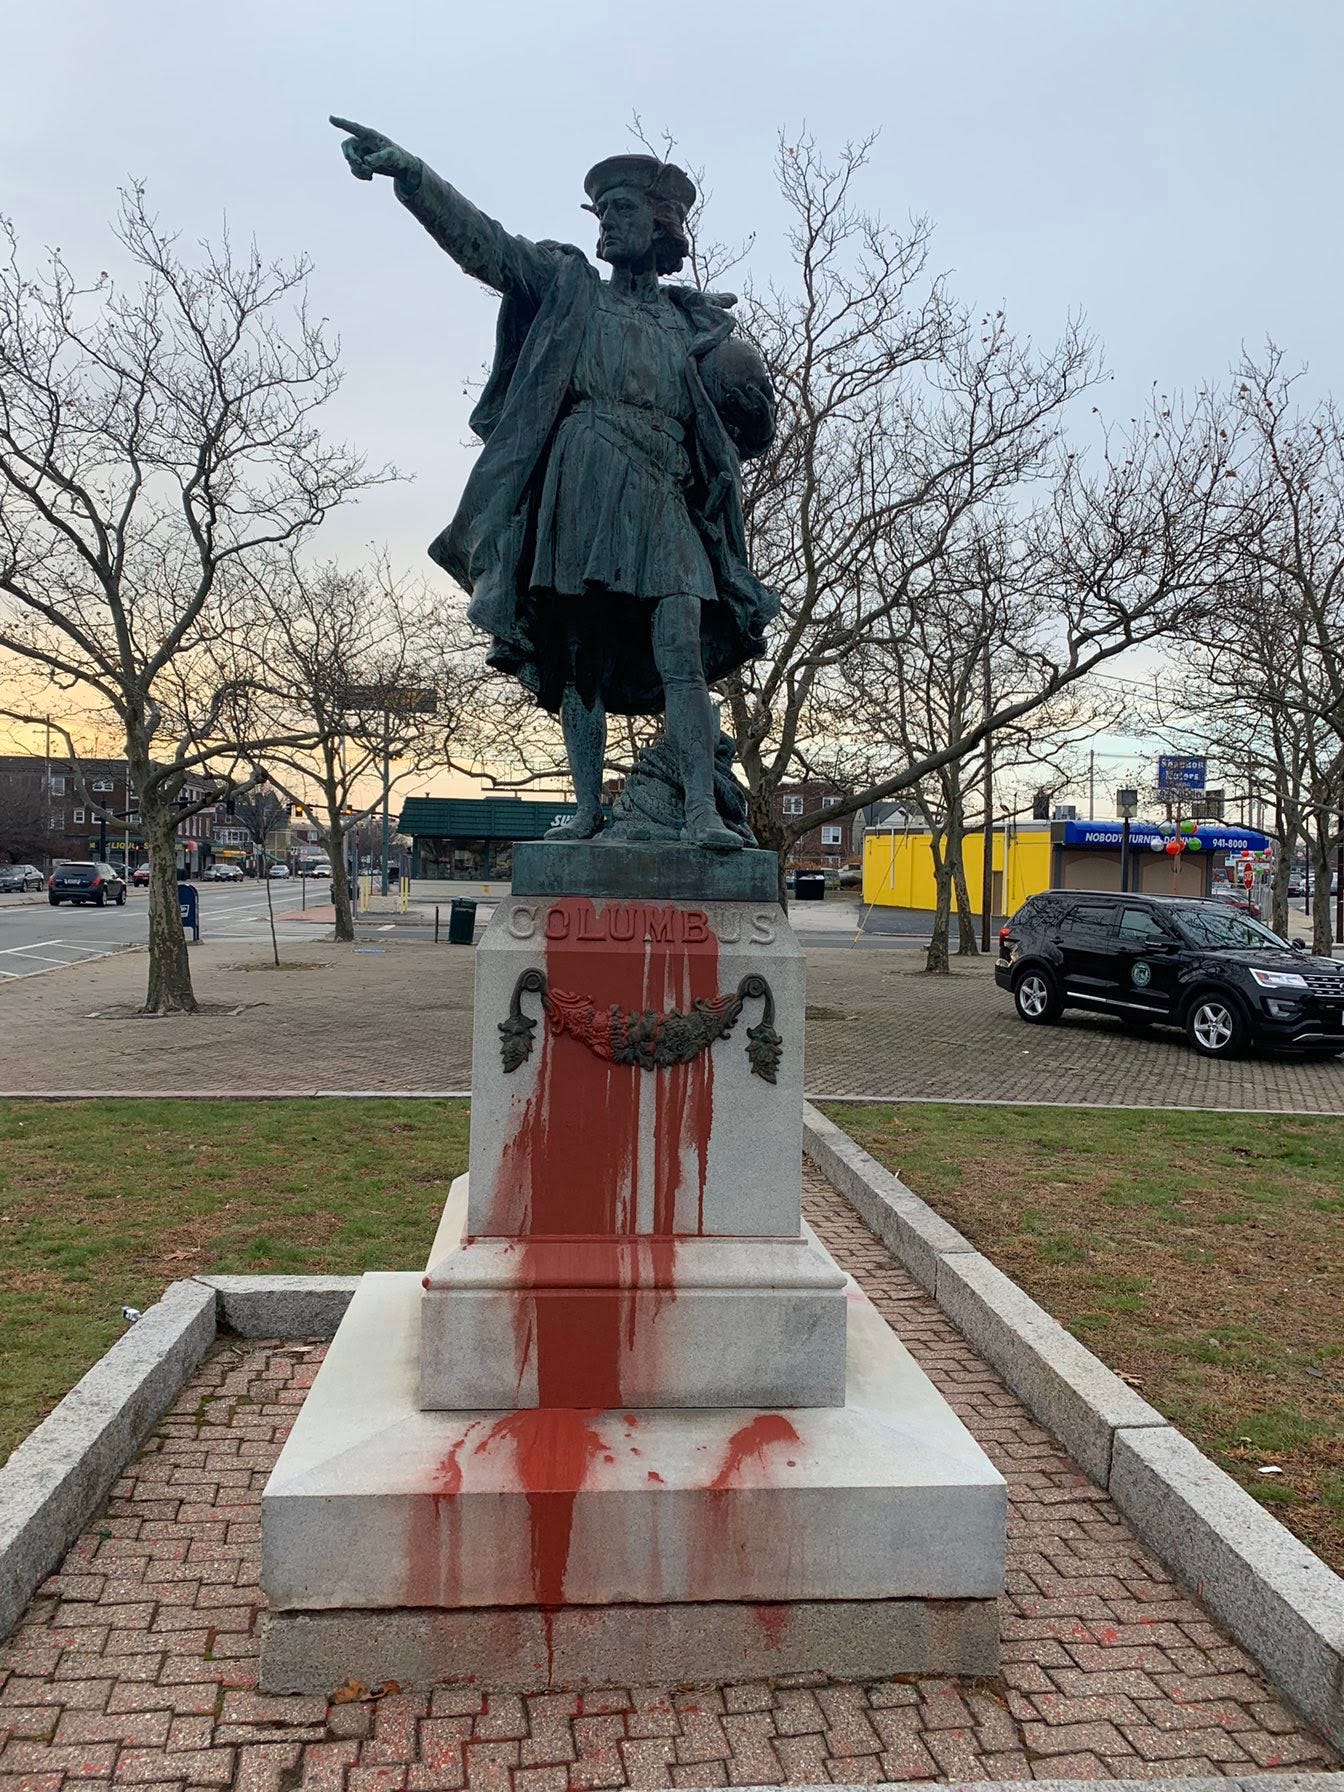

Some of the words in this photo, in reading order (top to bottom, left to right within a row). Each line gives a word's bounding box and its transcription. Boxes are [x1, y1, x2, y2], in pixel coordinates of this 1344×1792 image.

[550, 815, 574, 827] SU
[1085, 833, 1123, 842] NOBODY
[1212, 838, 1248, 848] 941-8000
[507, 905, 776, 945] COLUMBUS
